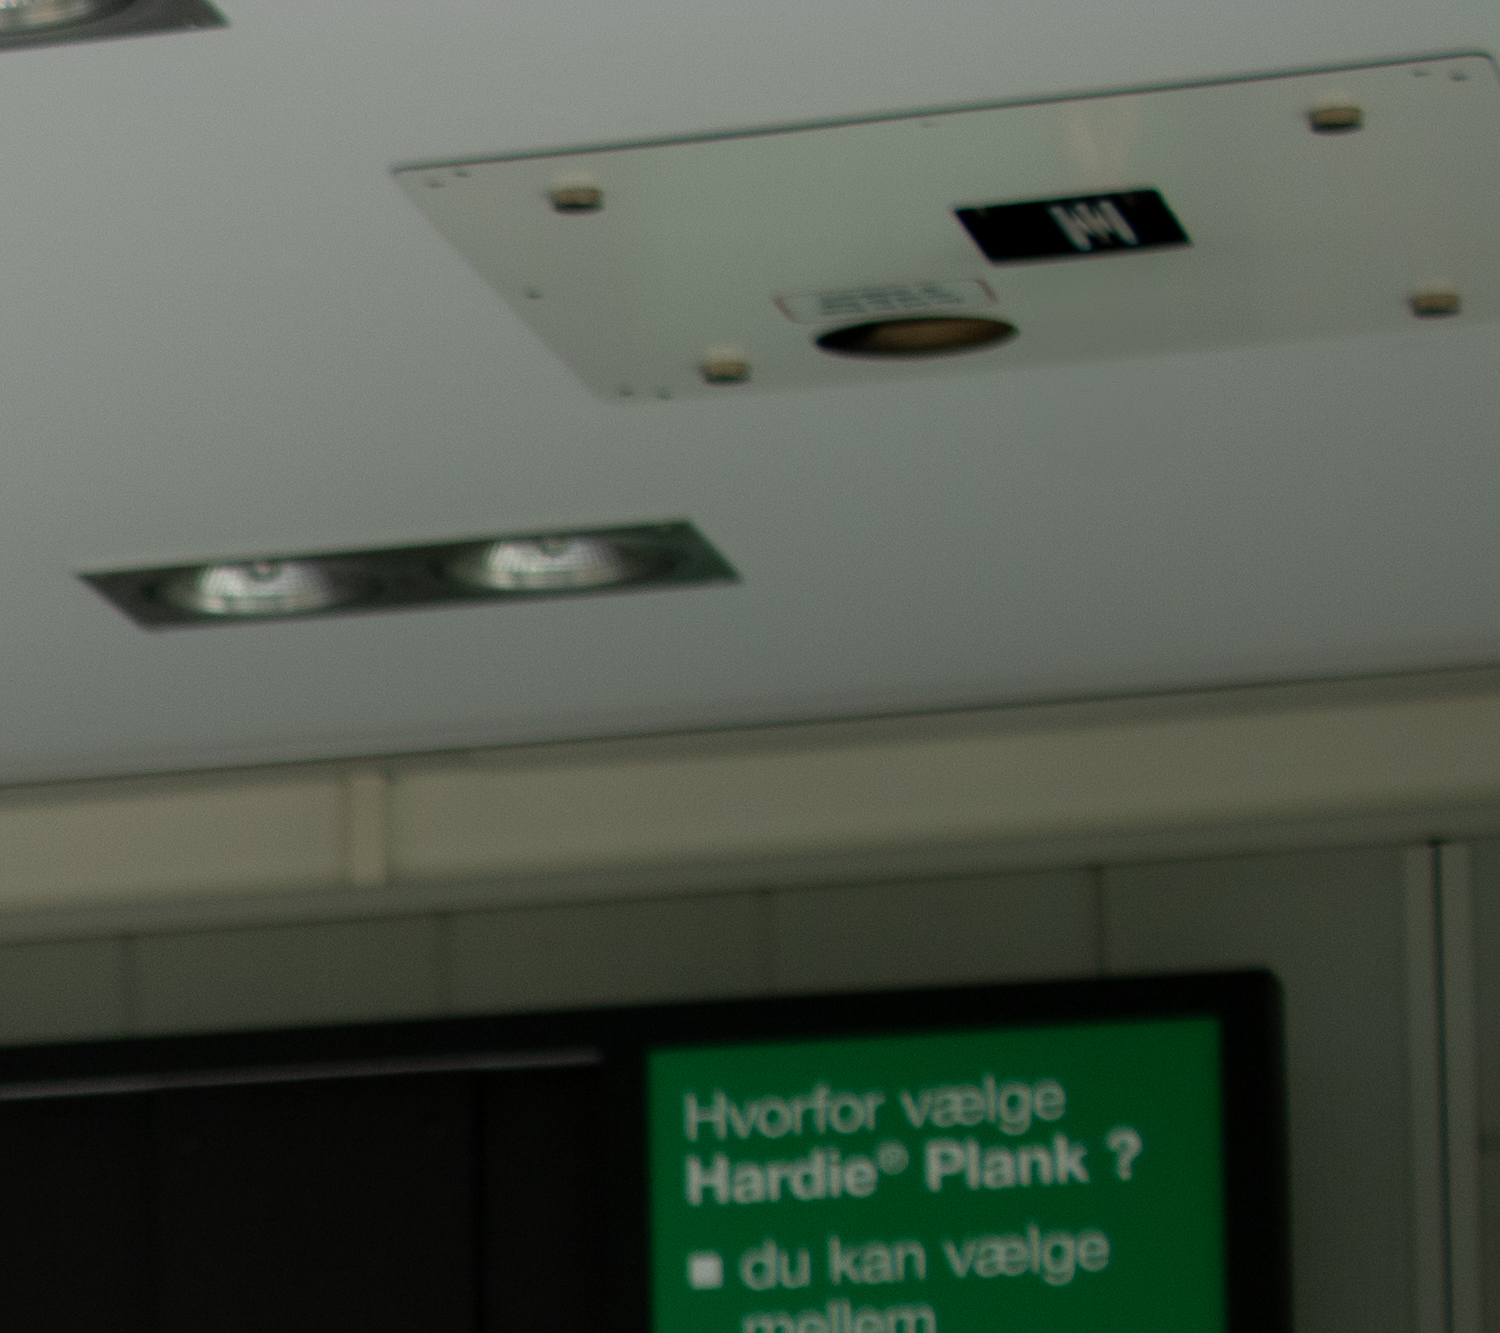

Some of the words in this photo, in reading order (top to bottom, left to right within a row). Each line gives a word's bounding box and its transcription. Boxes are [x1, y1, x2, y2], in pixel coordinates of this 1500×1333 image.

[683, 1083, 884, 1141] Hvorfor
[902, 1073, 1066, 1135] vælge
[684, 1140, 910, 1206] Hardie®
[923, 1132, 1090, 1192] Plank
[1105, 1126, 1143, 1182] ?
[739, 1236, 812, 1290] du
[828, 1234, 927, 1285] kan
[943, 1223, 1111, 1286] vælge
